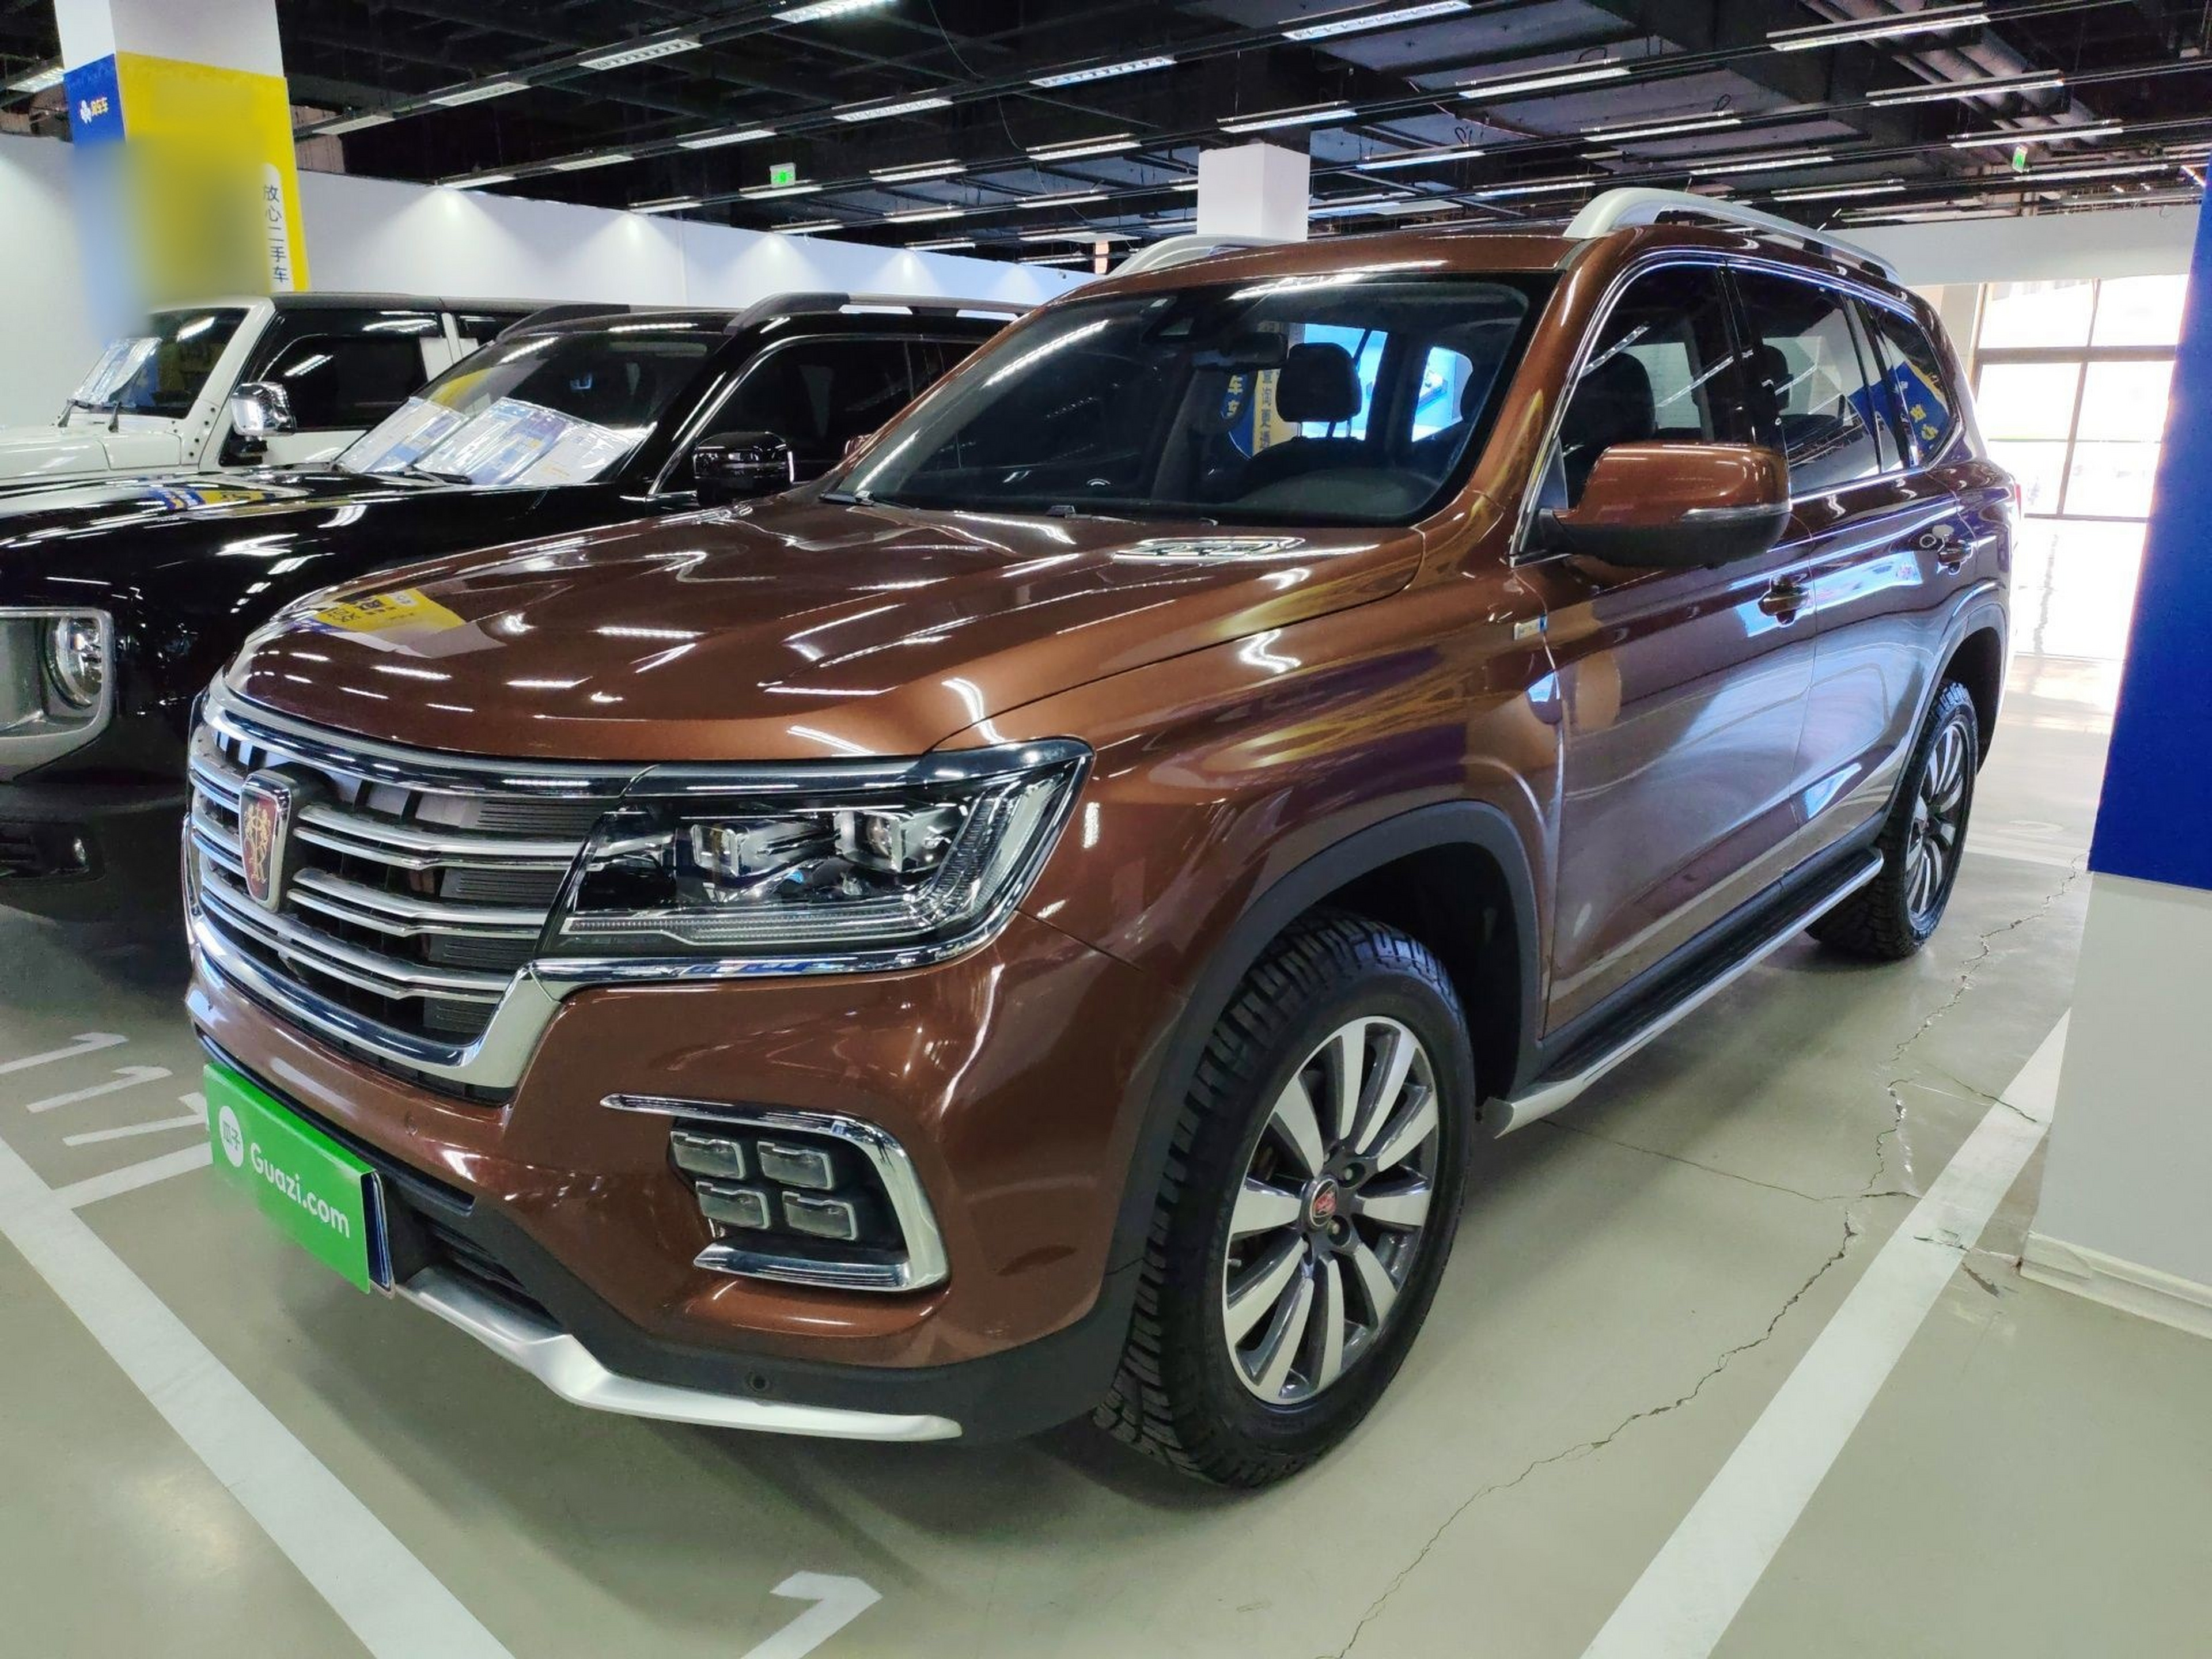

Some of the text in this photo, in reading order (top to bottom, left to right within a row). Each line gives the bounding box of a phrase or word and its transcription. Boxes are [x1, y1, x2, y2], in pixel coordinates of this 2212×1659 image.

[263, 184, 289, 282] 放心二手车
[221, 1120, 241, 1152] 瓜子
[251, 1142, 350, 1238] Guazi.com
